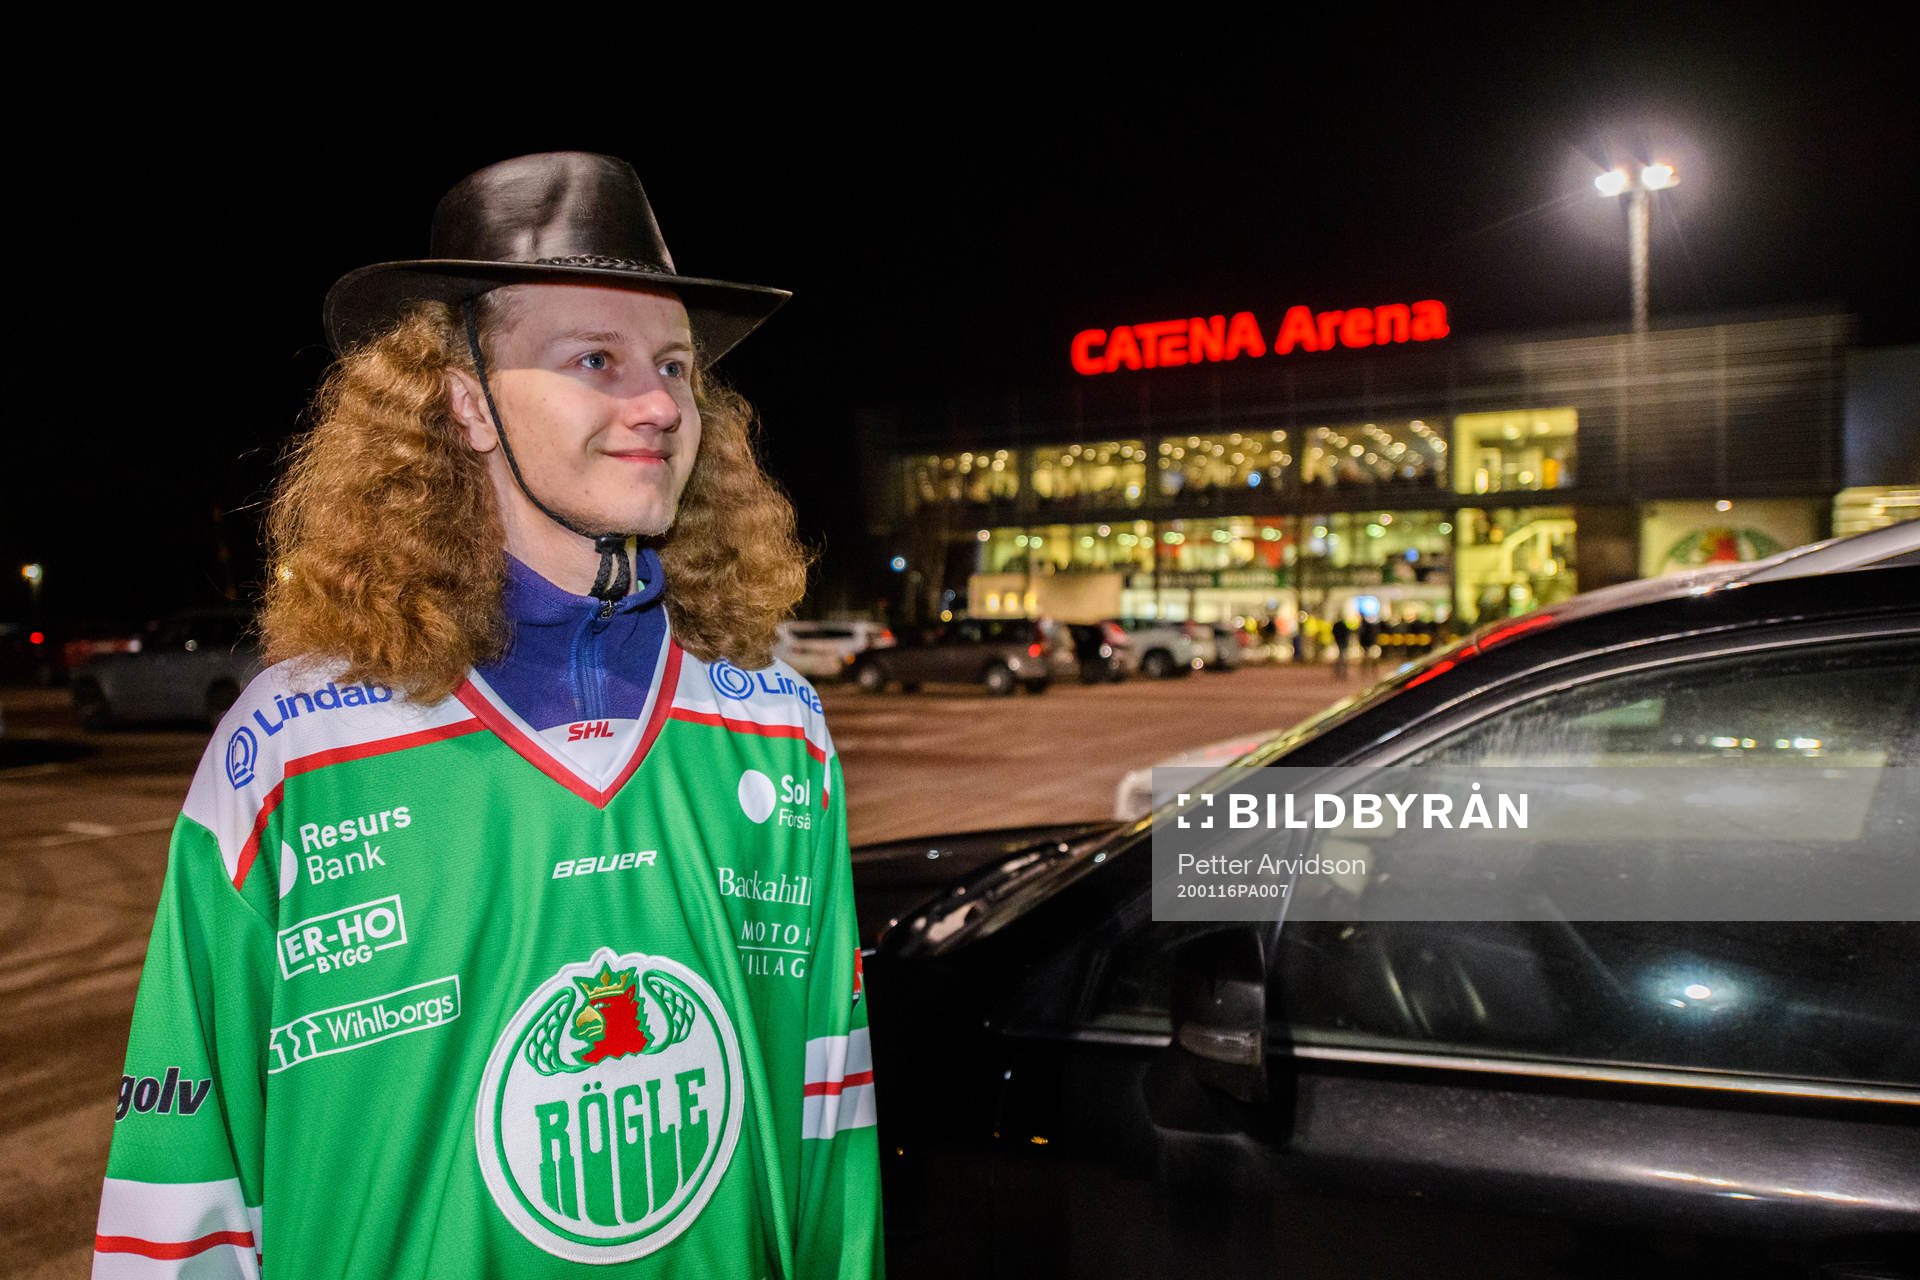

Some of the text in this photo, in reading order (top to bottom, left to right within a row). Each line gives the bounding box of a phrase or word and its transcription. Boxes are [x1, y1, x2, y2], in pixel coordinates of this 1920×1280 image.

[1071, 300, 1450, 375] CATENA Arena
[252, 681, 393, 737] Lindab
[567, 721, 615, 742] SHL
[300, 806, 411, 854] Resurs
[306, 842, 386, 885] Bank
[283, 907, 396, 966] ER-HO
[316, 944, 373, 974] BYGG
[741, 954, 806, 978] ILLAG
[325, 993, 454, 1043] Wihlborgs
[115, 1066, 212, 1122] golv
[535, 1067, 709, 1226] RÖGLE
